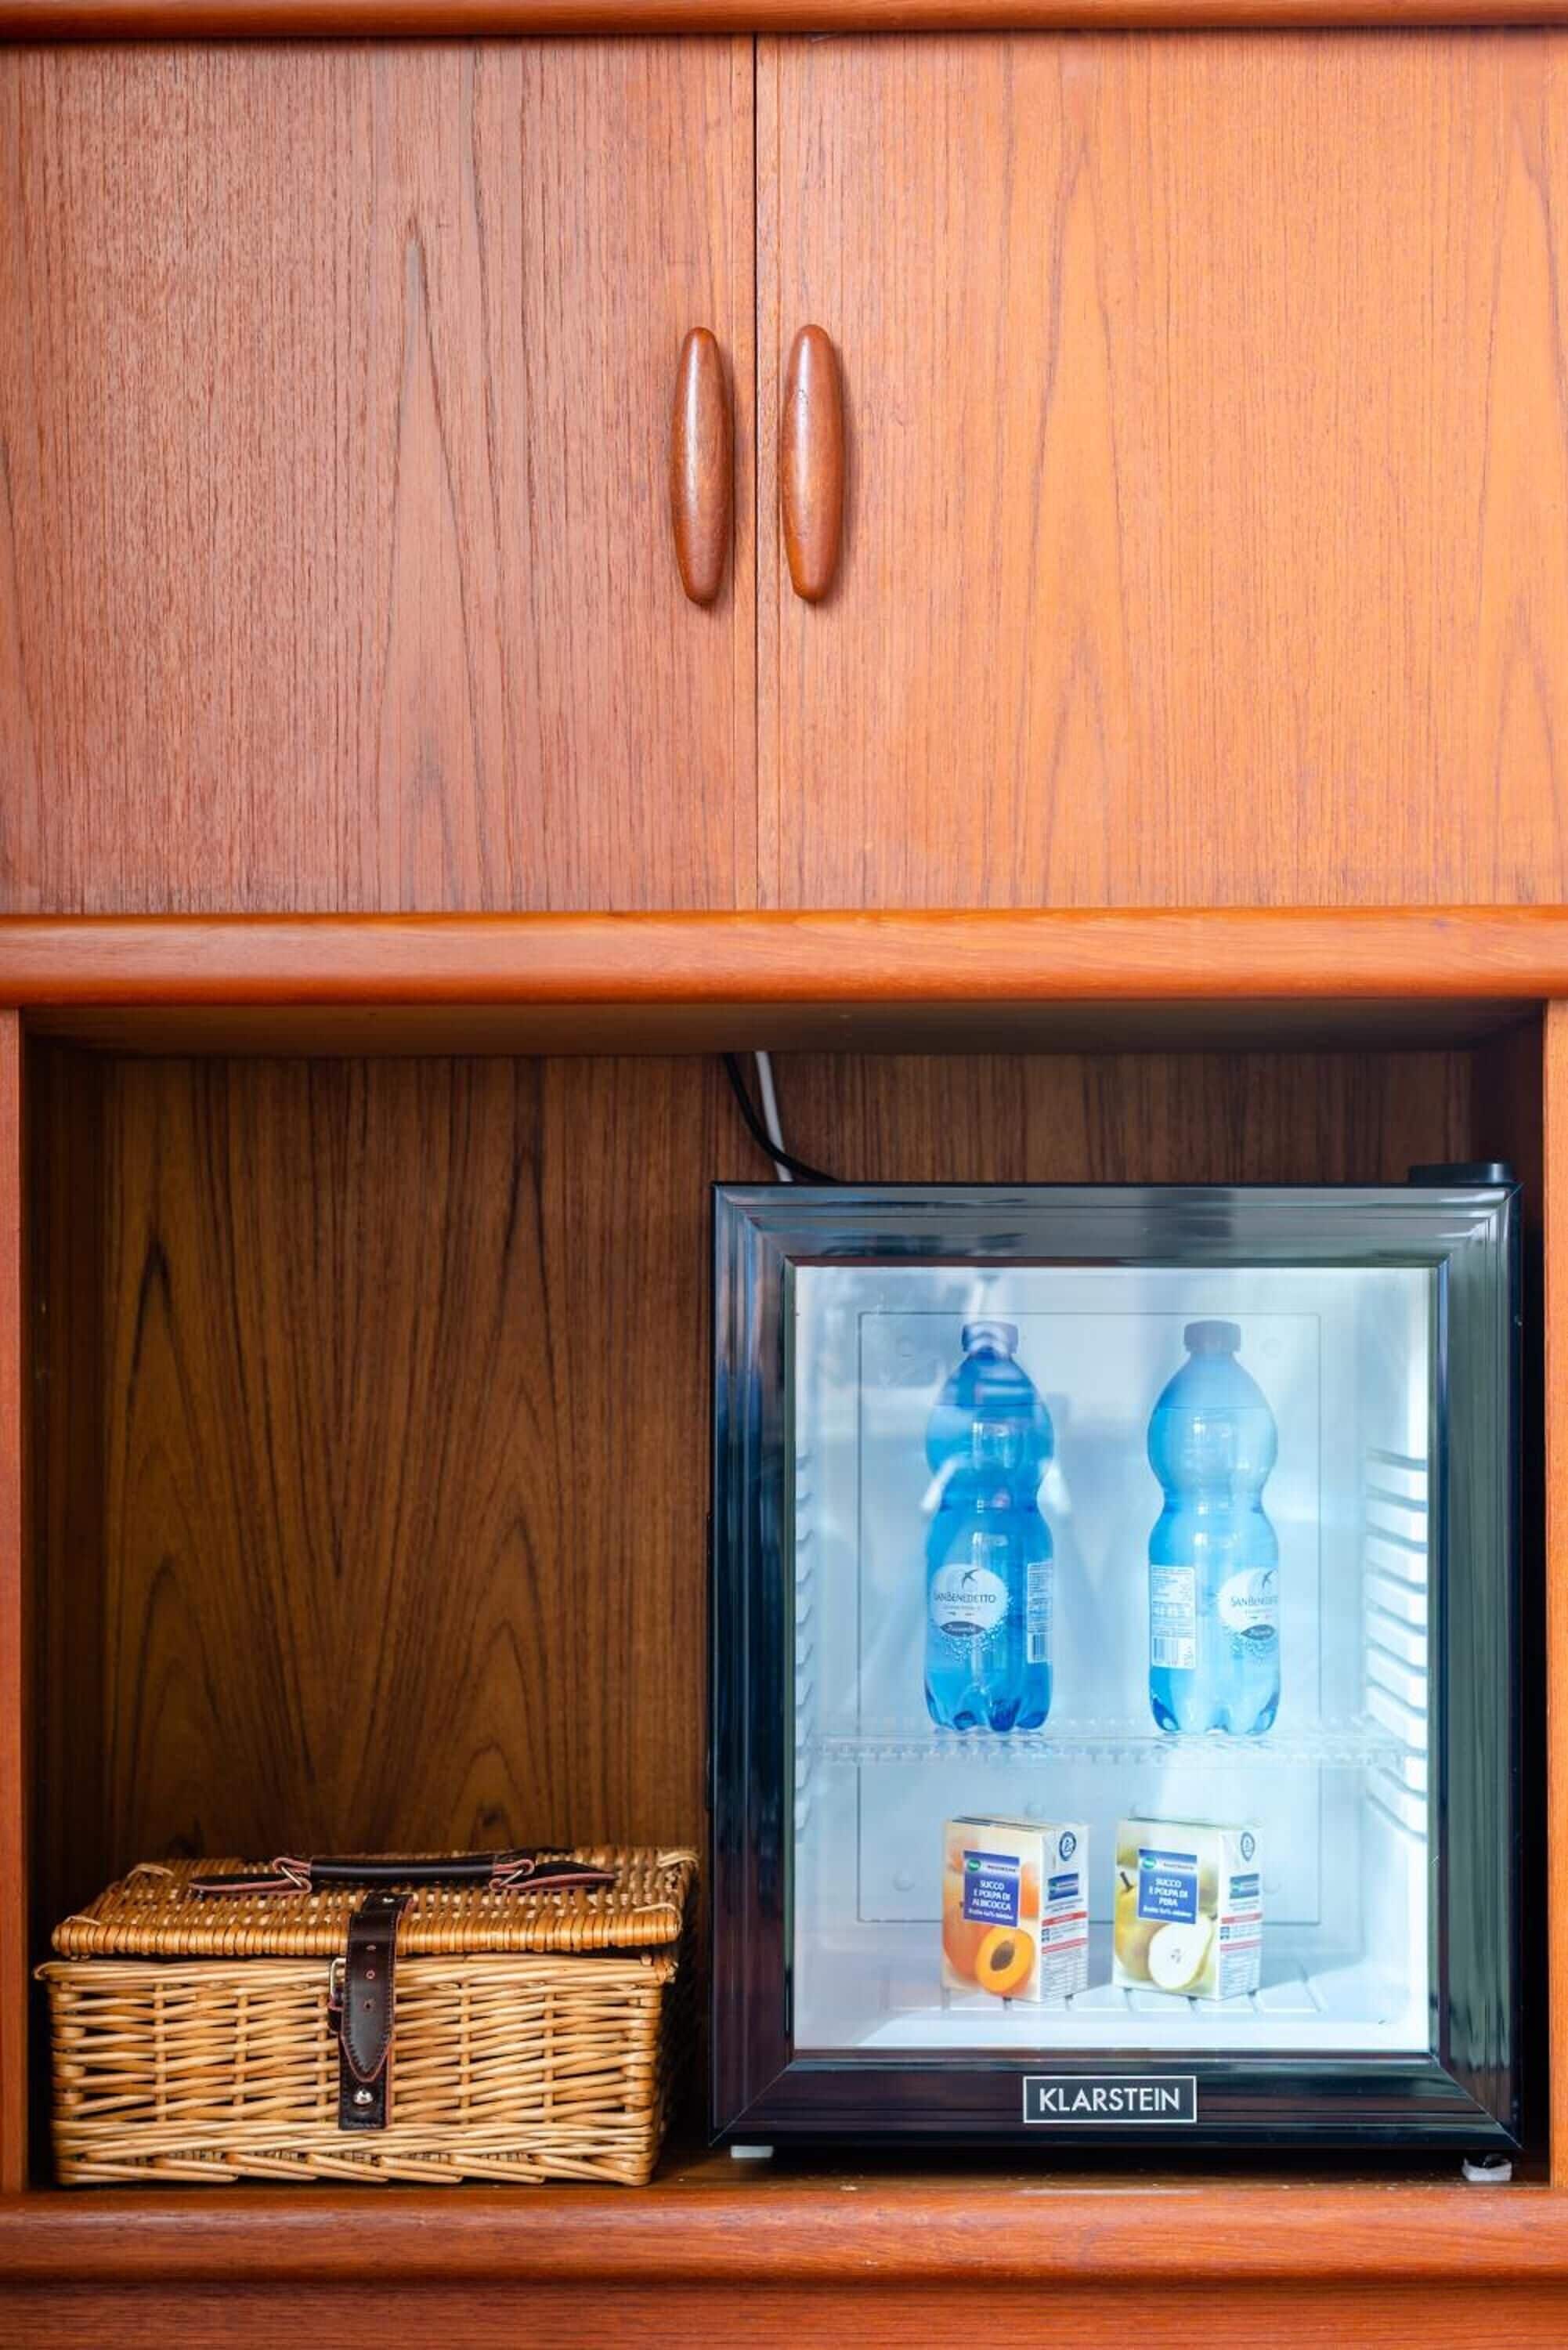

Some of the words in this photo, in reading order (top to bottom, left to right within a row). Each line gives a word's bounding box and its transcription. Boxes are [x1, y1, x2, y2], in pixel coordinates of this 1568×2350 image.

[980, 1880, 1004, 1890] SUCCO
[1155, 1878, 1182, 1888] SUCCO
[979, 1889, 1001, 1900] POLPA
[1003, 1893, 1010, 1901] DI
[972, 1898, 1011, 1911] ALBICOCCA
[1039, 2088, 1180, 2111] KLARSTEIN
